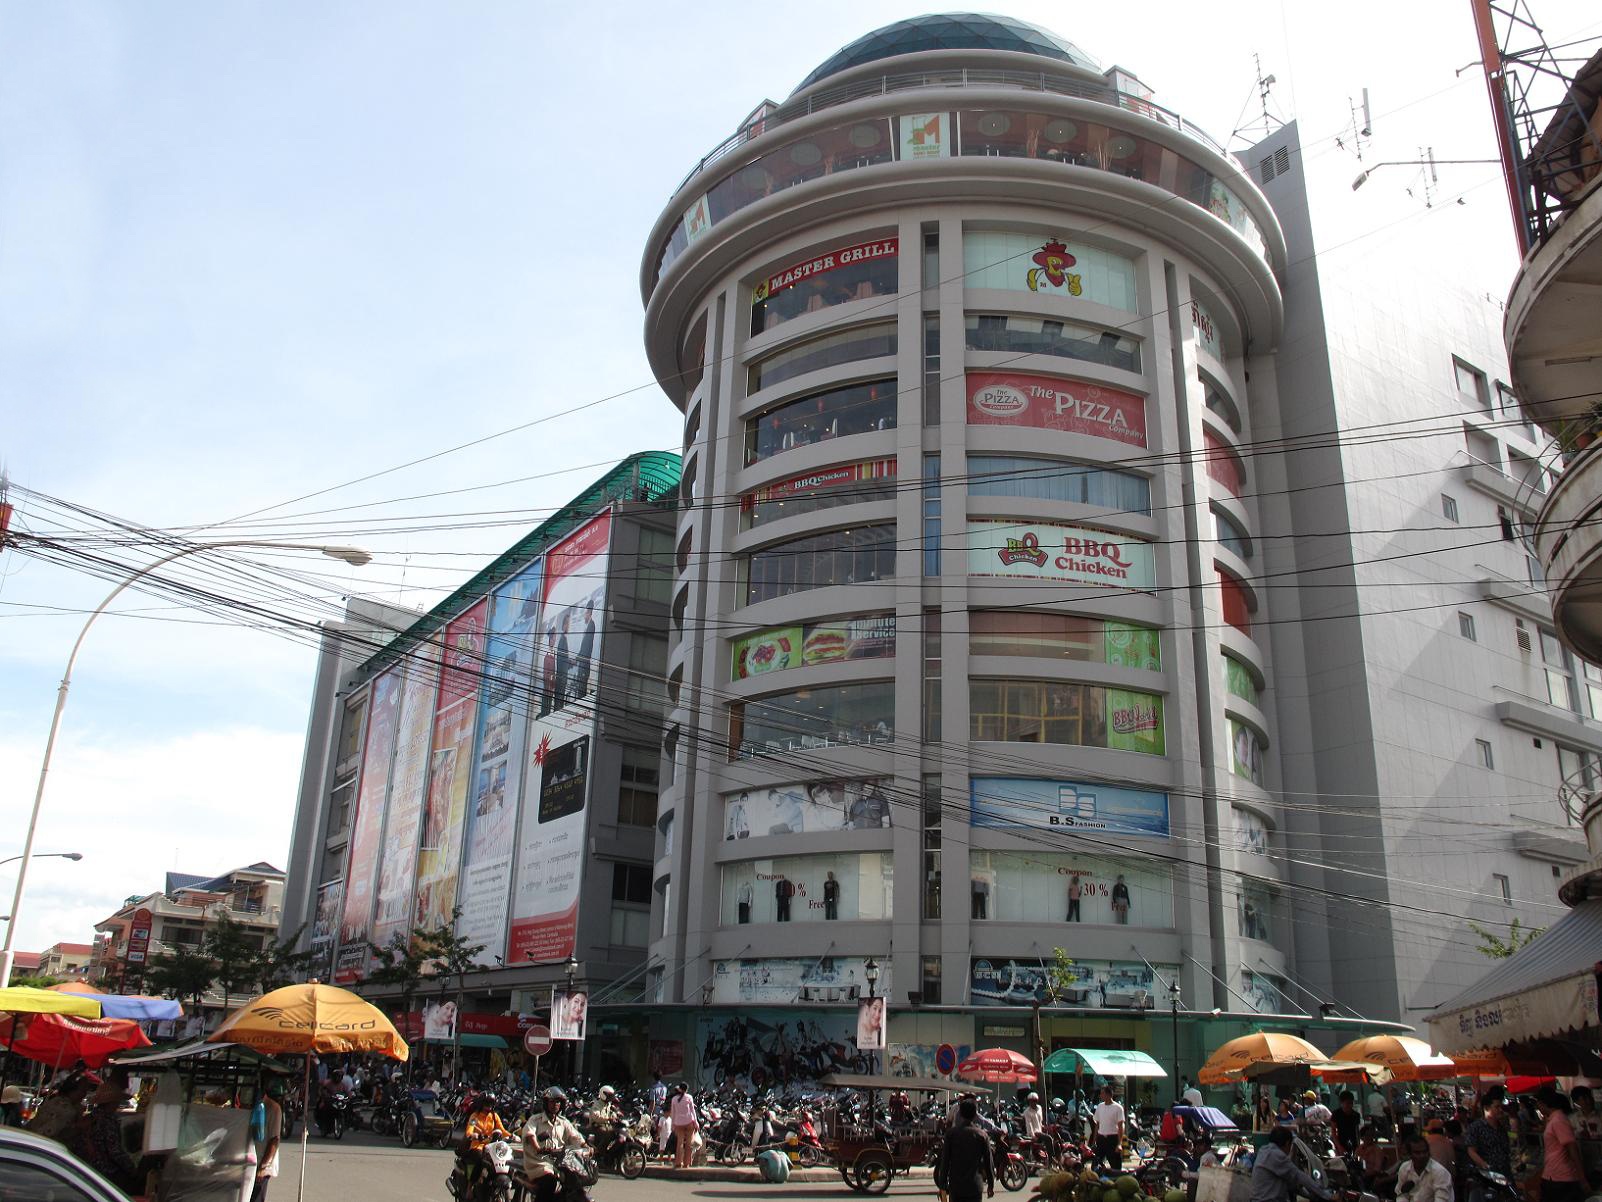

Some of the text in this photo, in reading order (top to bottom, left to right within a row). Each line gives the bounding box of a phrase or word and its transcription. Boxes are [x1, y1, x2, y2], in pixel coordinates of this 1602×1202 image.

[770, 242, 895, 290] MASTER GRILL
[984, 392, 1020, 405] PIZZA
[1030, 385, 1128, 428] The PIZZA
[1108, 423, 1144, 440] Company
[794, 470, 849, 489] BBQ Chicken
[1006, 531, 1040, 556] BBQ
[1063, 536, 1133, 568] BBQ
[1008, 553, 1039, 563] Chicken
[1054, 556, 1128, 579] Chicken
[1083, 882, 1109, 897] 30 %
